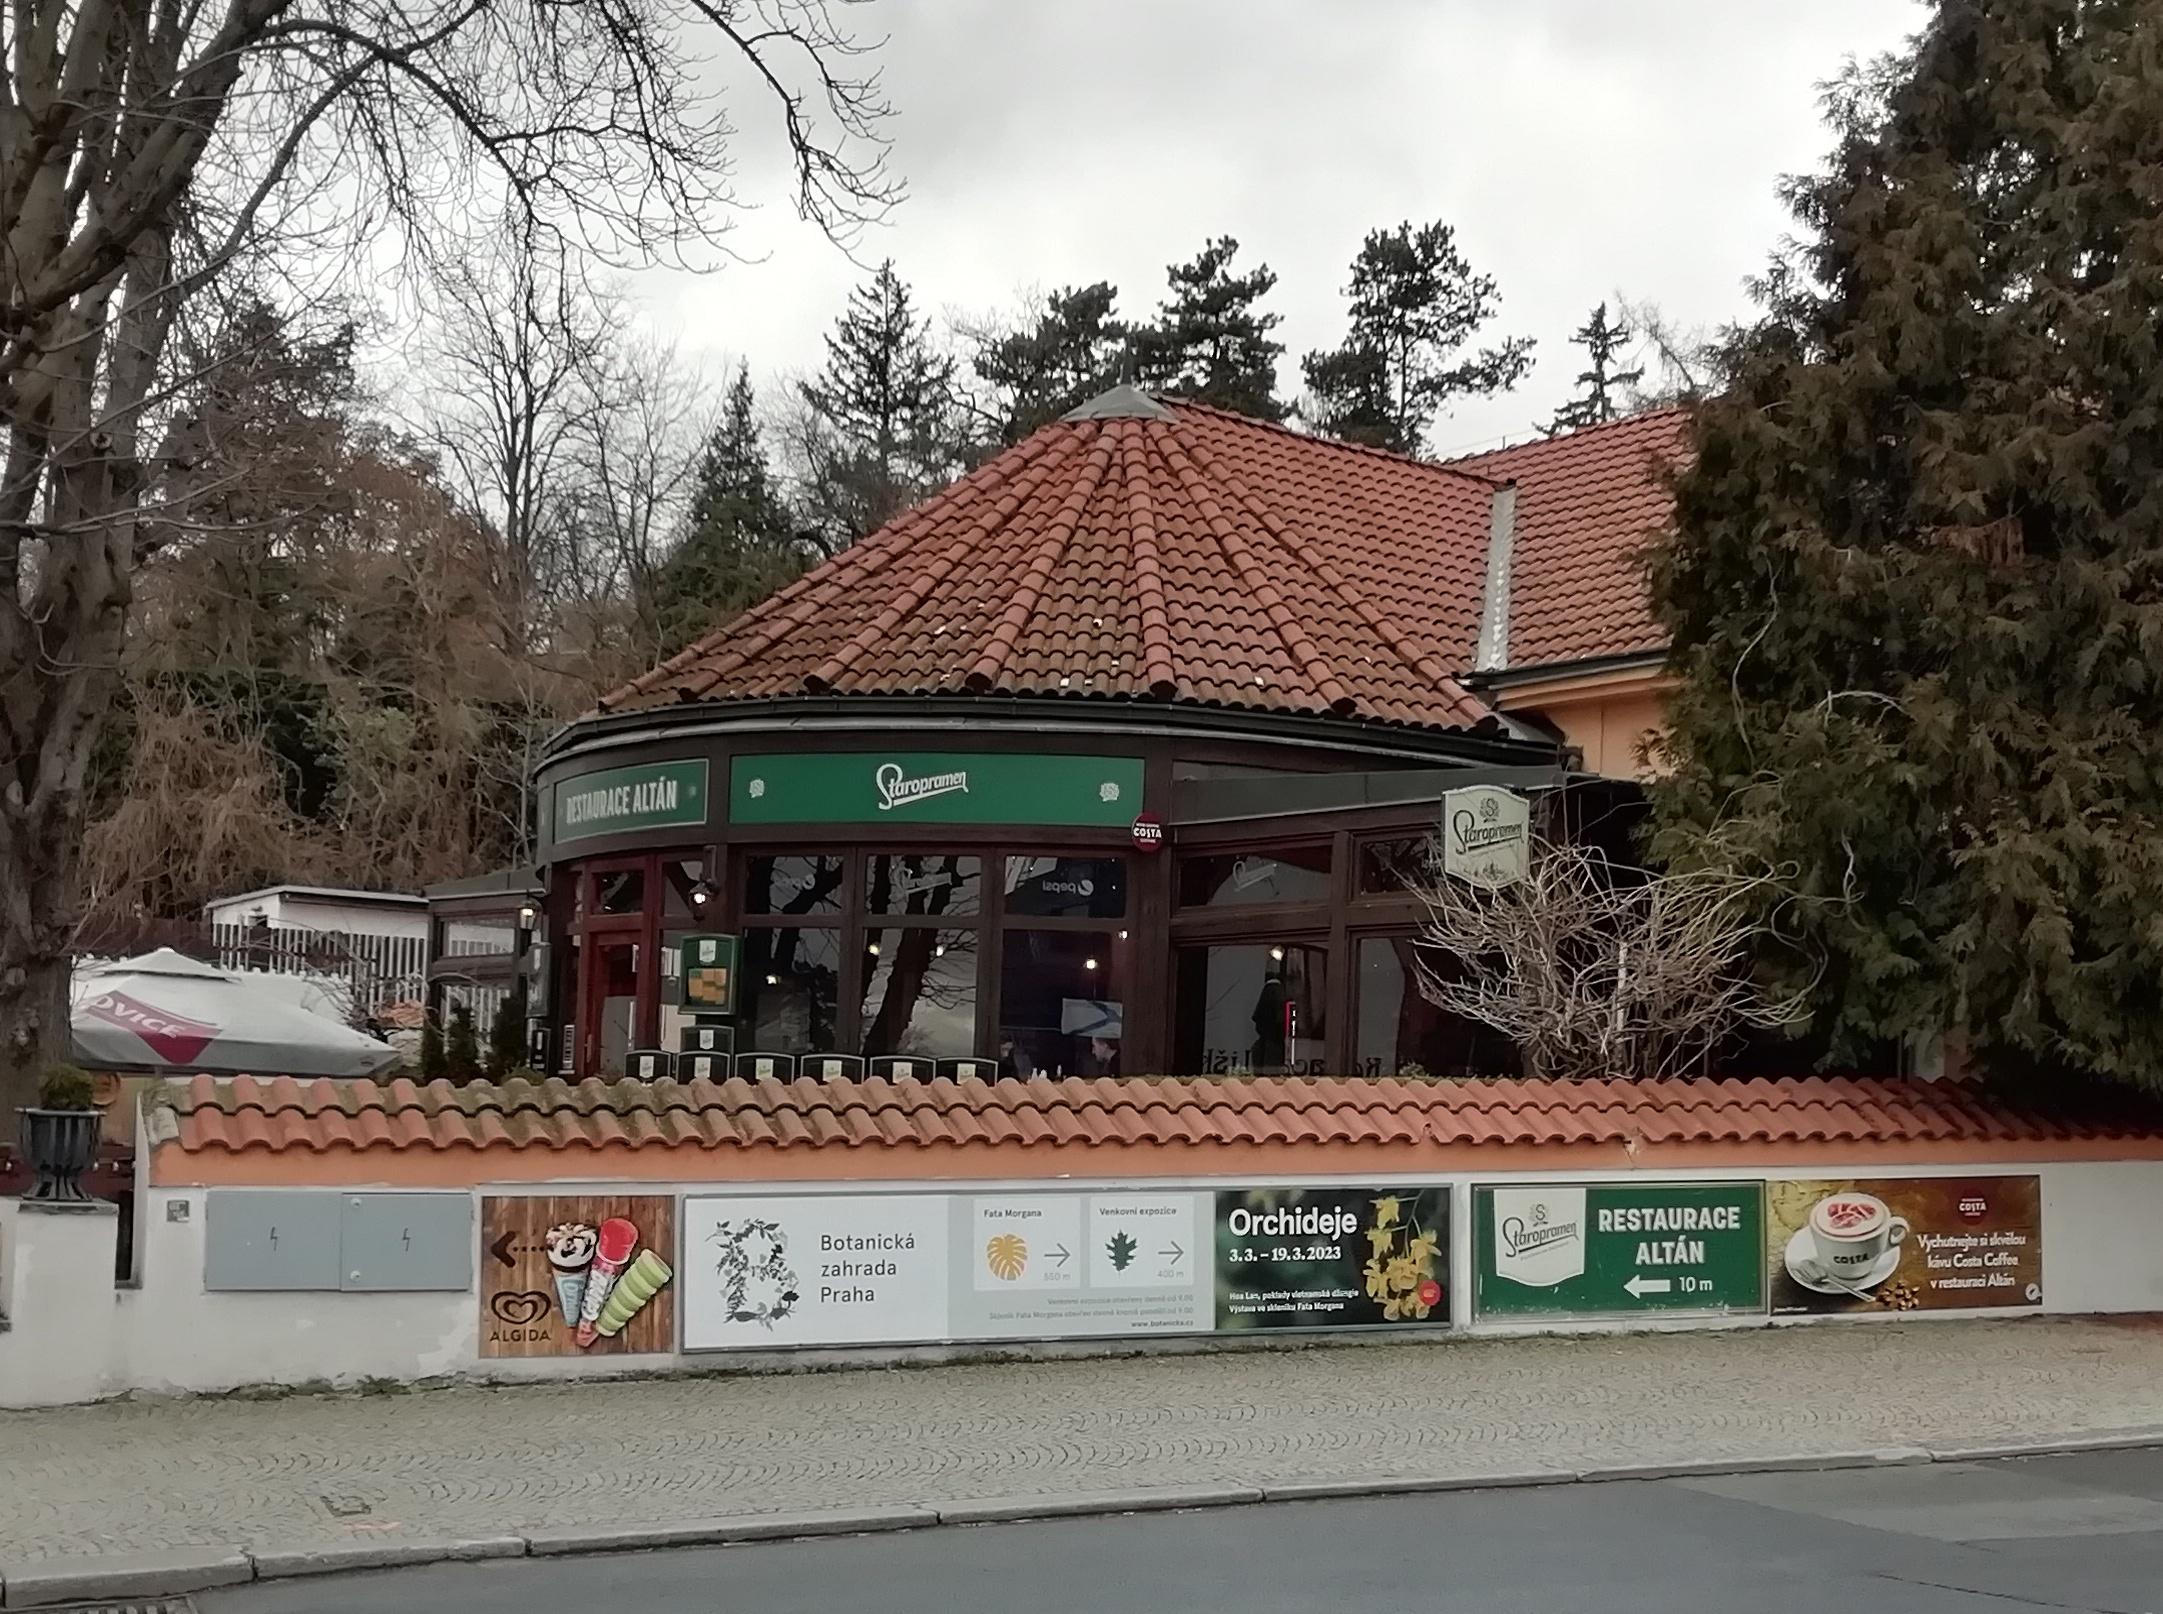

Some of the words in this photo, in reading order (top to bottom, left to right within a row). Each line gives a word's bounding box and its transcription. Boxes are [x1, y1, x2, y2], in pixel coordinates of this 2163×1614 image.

[876, 763, 969, 810] Staropramen
[565, 786, 630, 824] RESTAURACE
[633, 776, 677, 813] ALTÁN
[1133, 828, 1161, 838] COSTA
[1453, 810, 1524, 855] Staropramen
[984, 1209, 1002, 1218] Fata
[1005, 1208, 1042, 1220] Morgana
[1100, 1207, 1137, 1216] Venkovní
[1139, 1207, 1177, 1217] expozice
[1959, 1203, 1986, 1212] COSTA
[1229, 1206, 1357, 1241] Orchideje
[1598, 1206, 1741, 1232] RESTAURACE
[821, 1233, 914, 1251] Botanická
[1503, 1217, 1579, 1257] Staropramen
[1917, 1233, 1978, 1252] Vychutnejte
[1980, 1233, 1988, 1246] si
[1229, 1248, 1258, 1262] 3.3.
[1271, 1246, 1341, 1261] 19.3.2023
[1635, 1235, 1705, 1265] ALTÁN
[1833, 1253, 1869, 1264] COSTA
[1927, 1254, 1951, 1268] kávu
[1953, 1253, 1982, 1267] Costa
[1984, 1252, 2018, 1266] Coffee
[821, 1259, 896, 1277] zahrada
[1679, 1276, 1696, 1293] 10
[1699, 1279, 1713, 1291] m
[1930, 1280, 1938, 1288] v
[1939, 1274, 1986, 1288] restauraci
[1988, 1272, 2015, 1287] Altán
[821, 1286, 874, 1302] Praha
[1297, 1302, 1312, 1311] Fata
[1314, 1301, 1344, 1312] Morgana
[489, 1328, 552, 1343] ALGIDA
